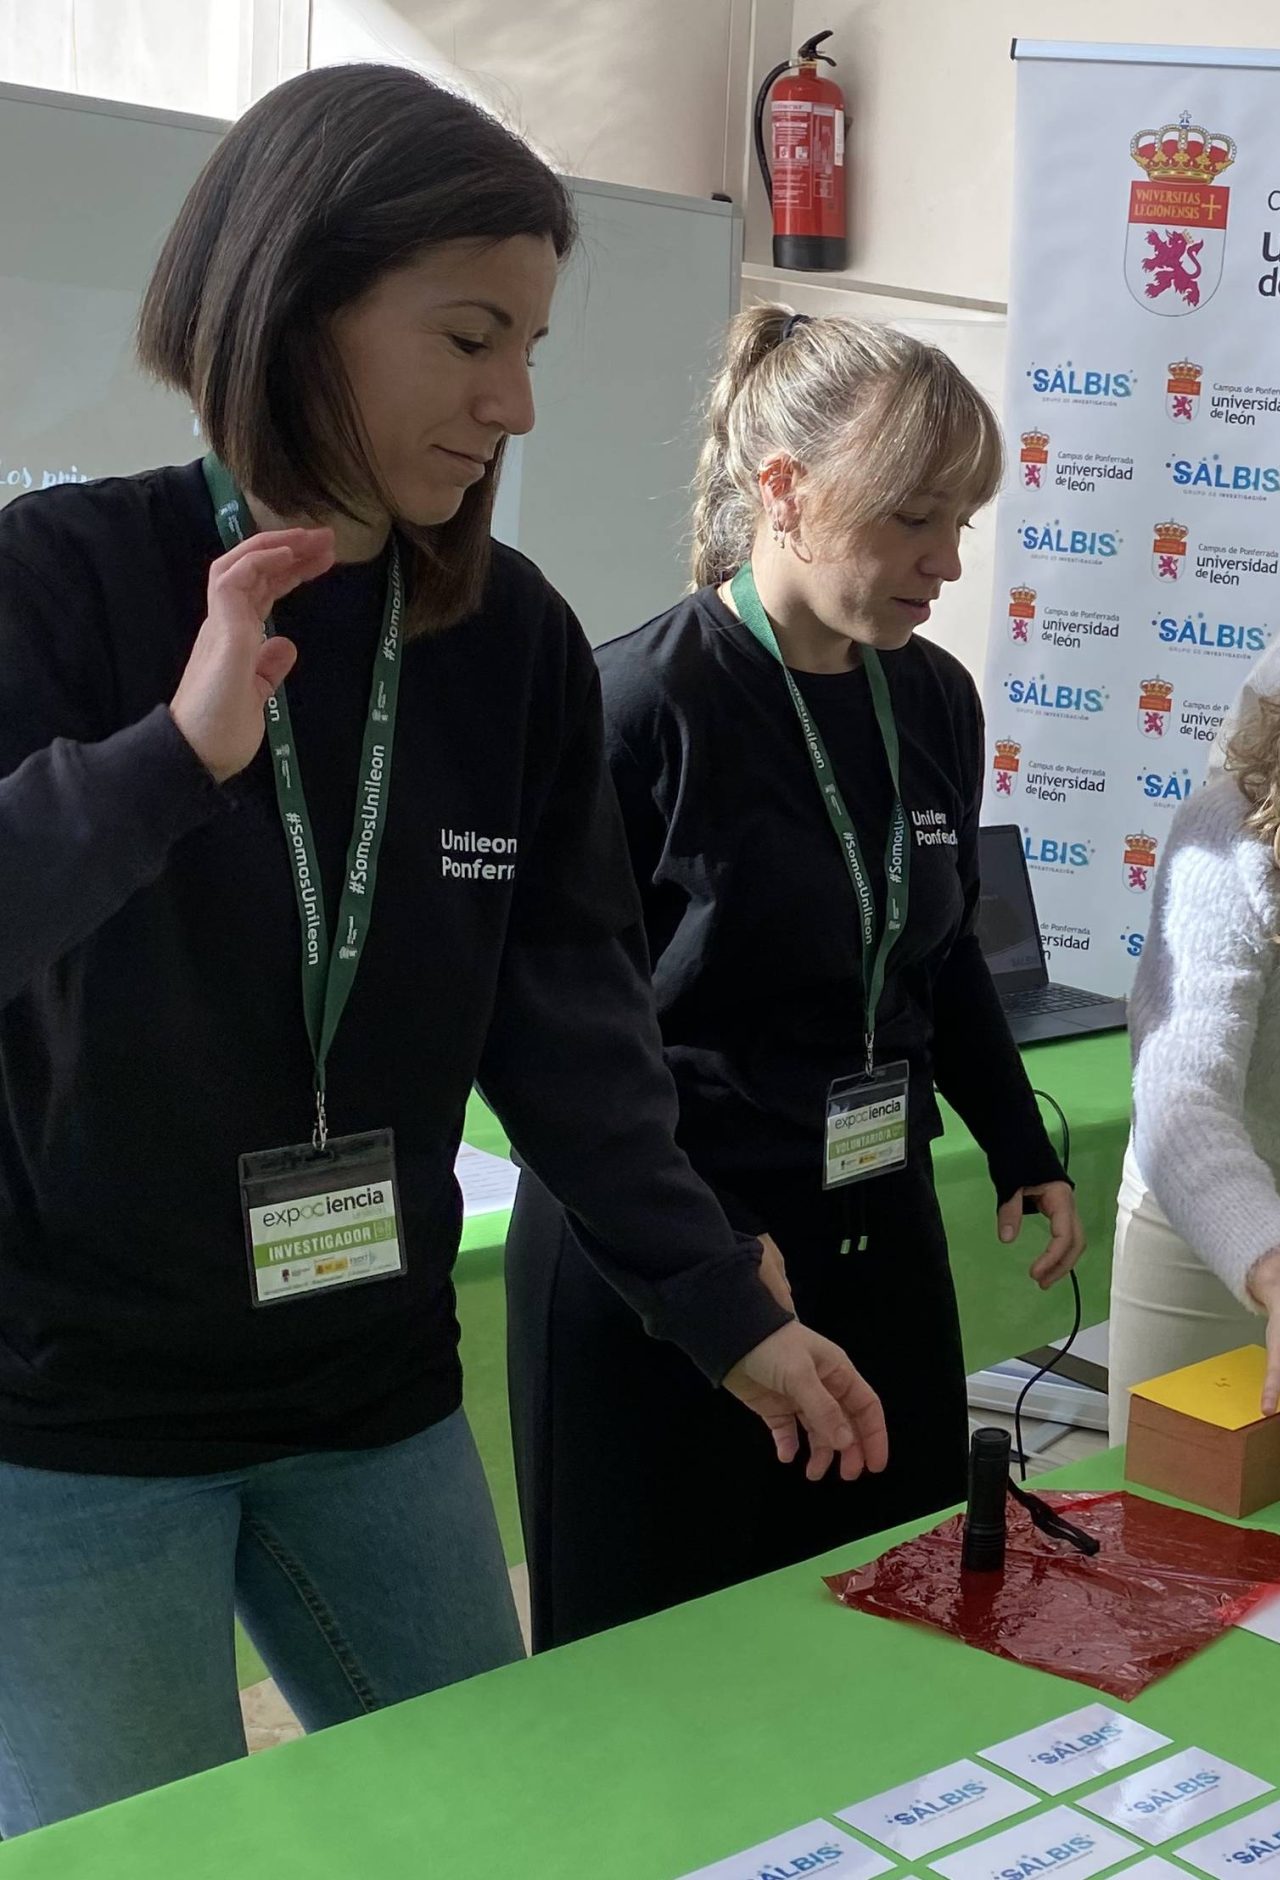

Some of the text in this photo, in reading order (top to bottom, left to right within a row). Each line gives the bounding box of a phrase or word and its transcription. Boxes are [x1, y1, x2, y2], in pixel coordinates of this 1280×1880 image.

[1032, 367, 1132, 398] SALBIS
[1210, 407, 1256, 426] de león
[1055, 475, 1095, 492] de león
[1056, 462, 1133, 481] universidad
[1173, 460, 1280, 492] SALBIS
[1022, 526, 1118, 557] SALBIS
[1195, 568, 1240, 586] de león
[1197, 554, 1278, 574] universidad
[1041, 630, 1081, 648] de león
[1042, 618, 1119, 637] universidad
[1159, 618, 1266, 651] SALBIS
[1008, 679, 1104, 712] SALBIS
[1180, 725, 1216, 741] de leó
[1025, 785, 1066, 802] de león
[1027, 771, 1105, 793] universidad
[349, 744, 385, 894] #SomosUnileon
[441, 828, 517, 854] Unileon
[285, 812, 319, 965] #SomosUnileon
[843, 832, 872, 945] #SomosUnileon
[269, 1226, 372, 1261] INVESTIGADOR
[1036, 1724, 1124, 1766] SALBIS
[893, 1782, 988, 1826] SALBIS
[1133, 1770, 1221, 1814] SALBIS
[1000, 1837, 1096, 1880] SALBIS
